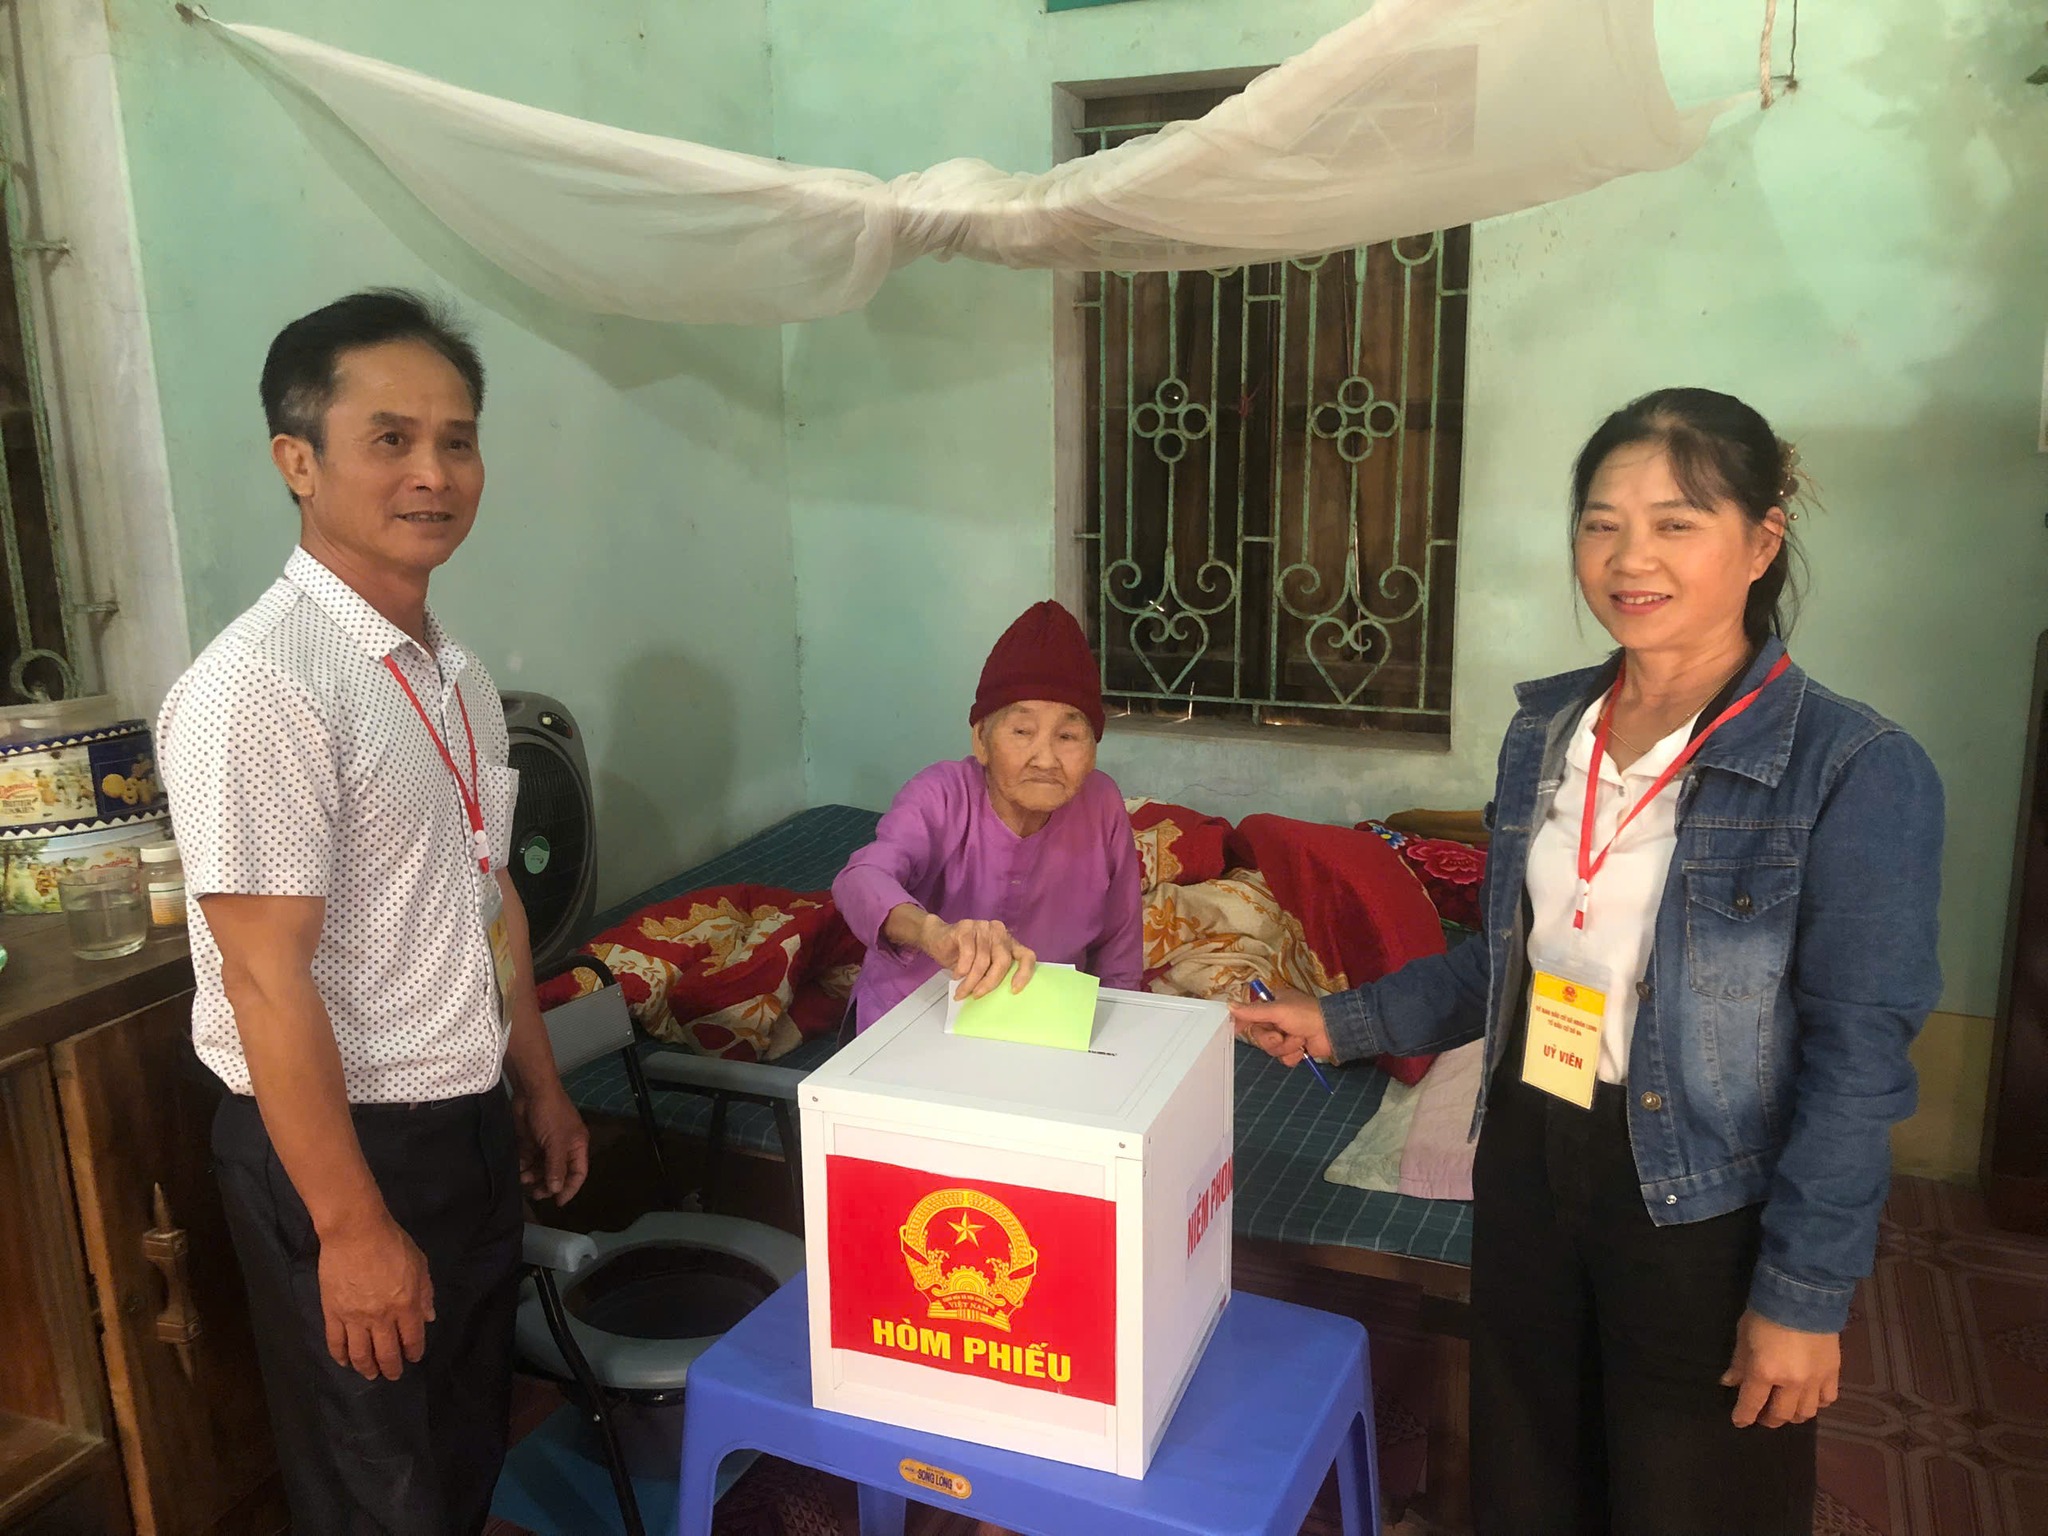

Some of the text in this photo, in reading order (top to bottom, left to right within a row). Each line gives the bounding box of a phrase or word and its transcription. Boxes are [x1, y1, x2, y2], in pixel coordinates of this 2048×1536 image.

[1559, 1050, 1583, 1070] VIÊN
[872, 1318, 1071, 1383] HÒM PHIẾU
[917, 1468, 935, 1485] SONG
